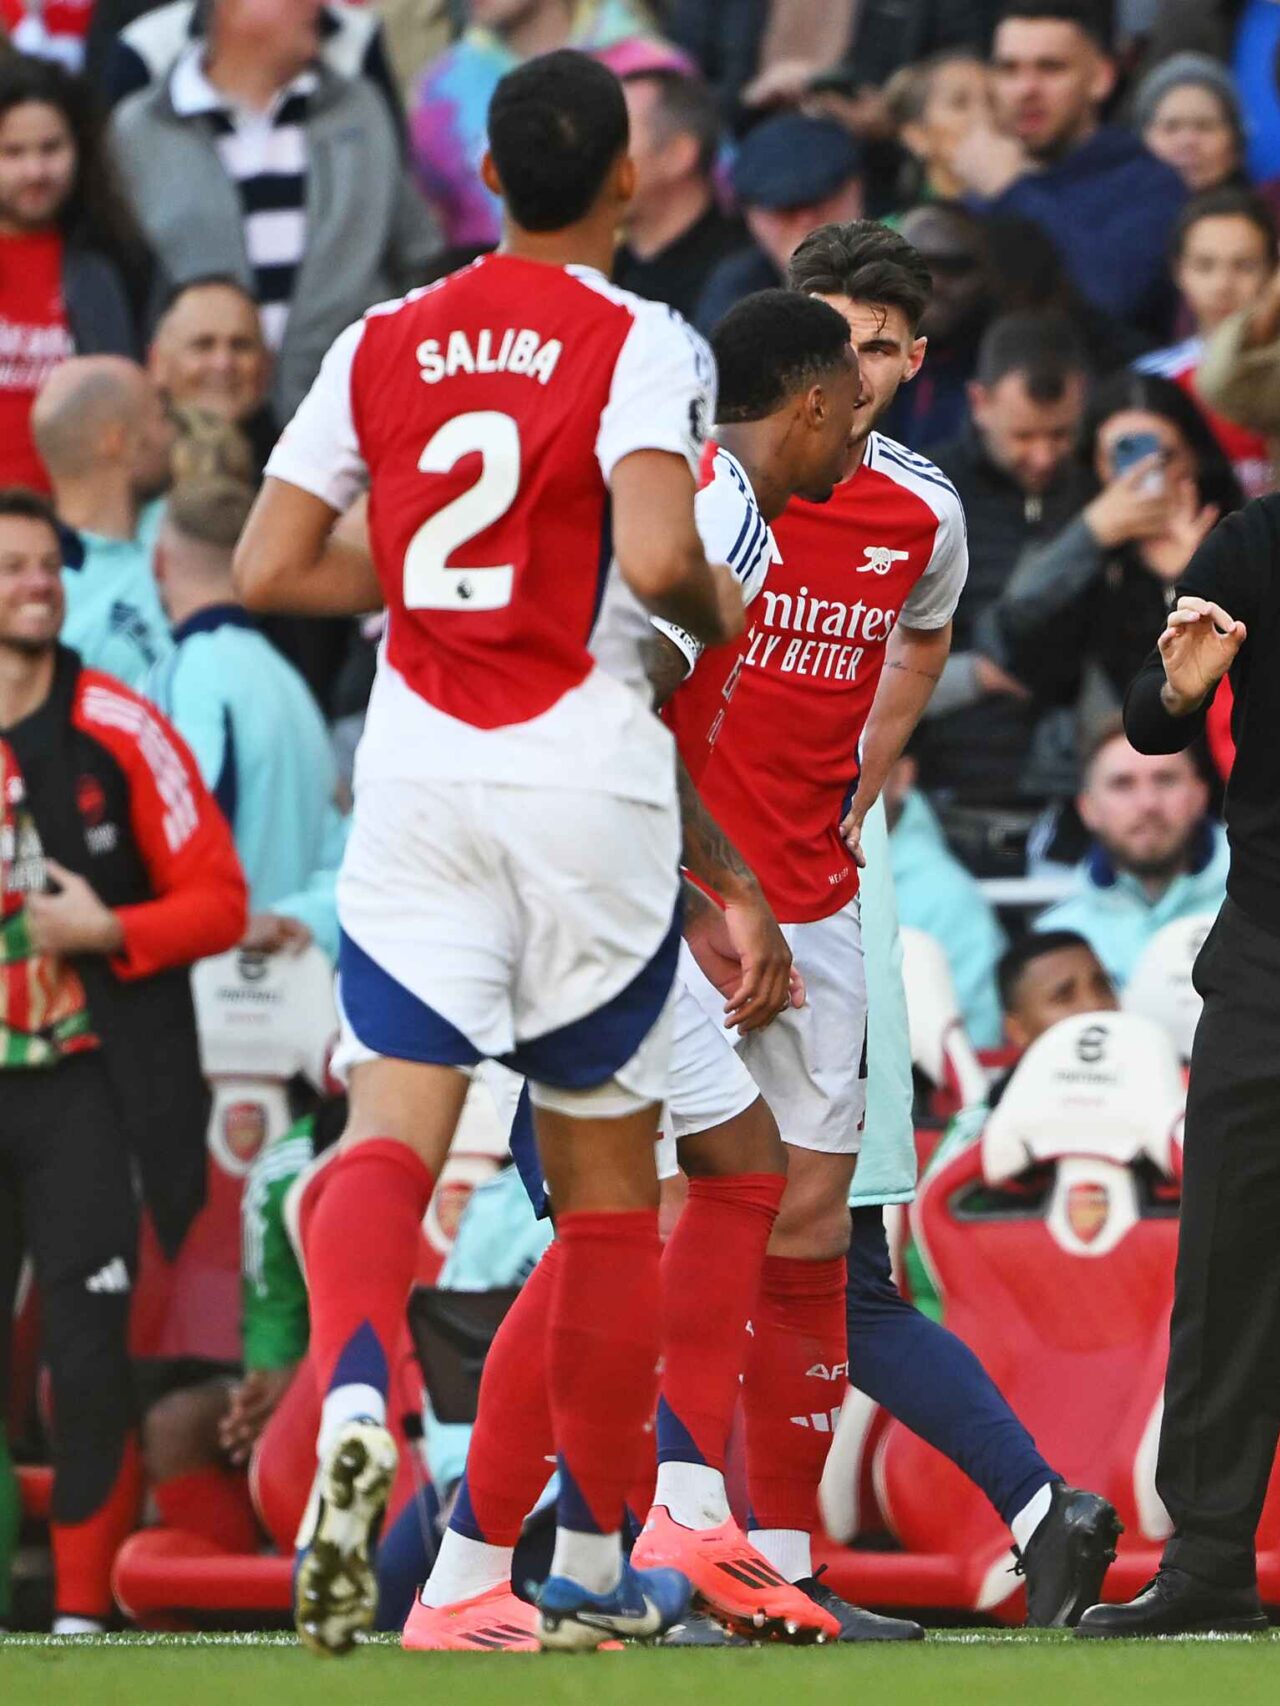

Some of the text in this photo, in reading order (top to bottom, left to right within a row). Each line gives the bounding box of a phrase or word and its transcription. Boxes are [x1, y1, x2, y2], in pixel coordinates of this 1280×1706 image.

[416, 328, 563, 385] SALIBA
[403, 410, 521, 612] 2
[762, 586, 896, 642] mirates
[745, 631, 782, 668] LY
[780, 638, 864, 681] BETTER
